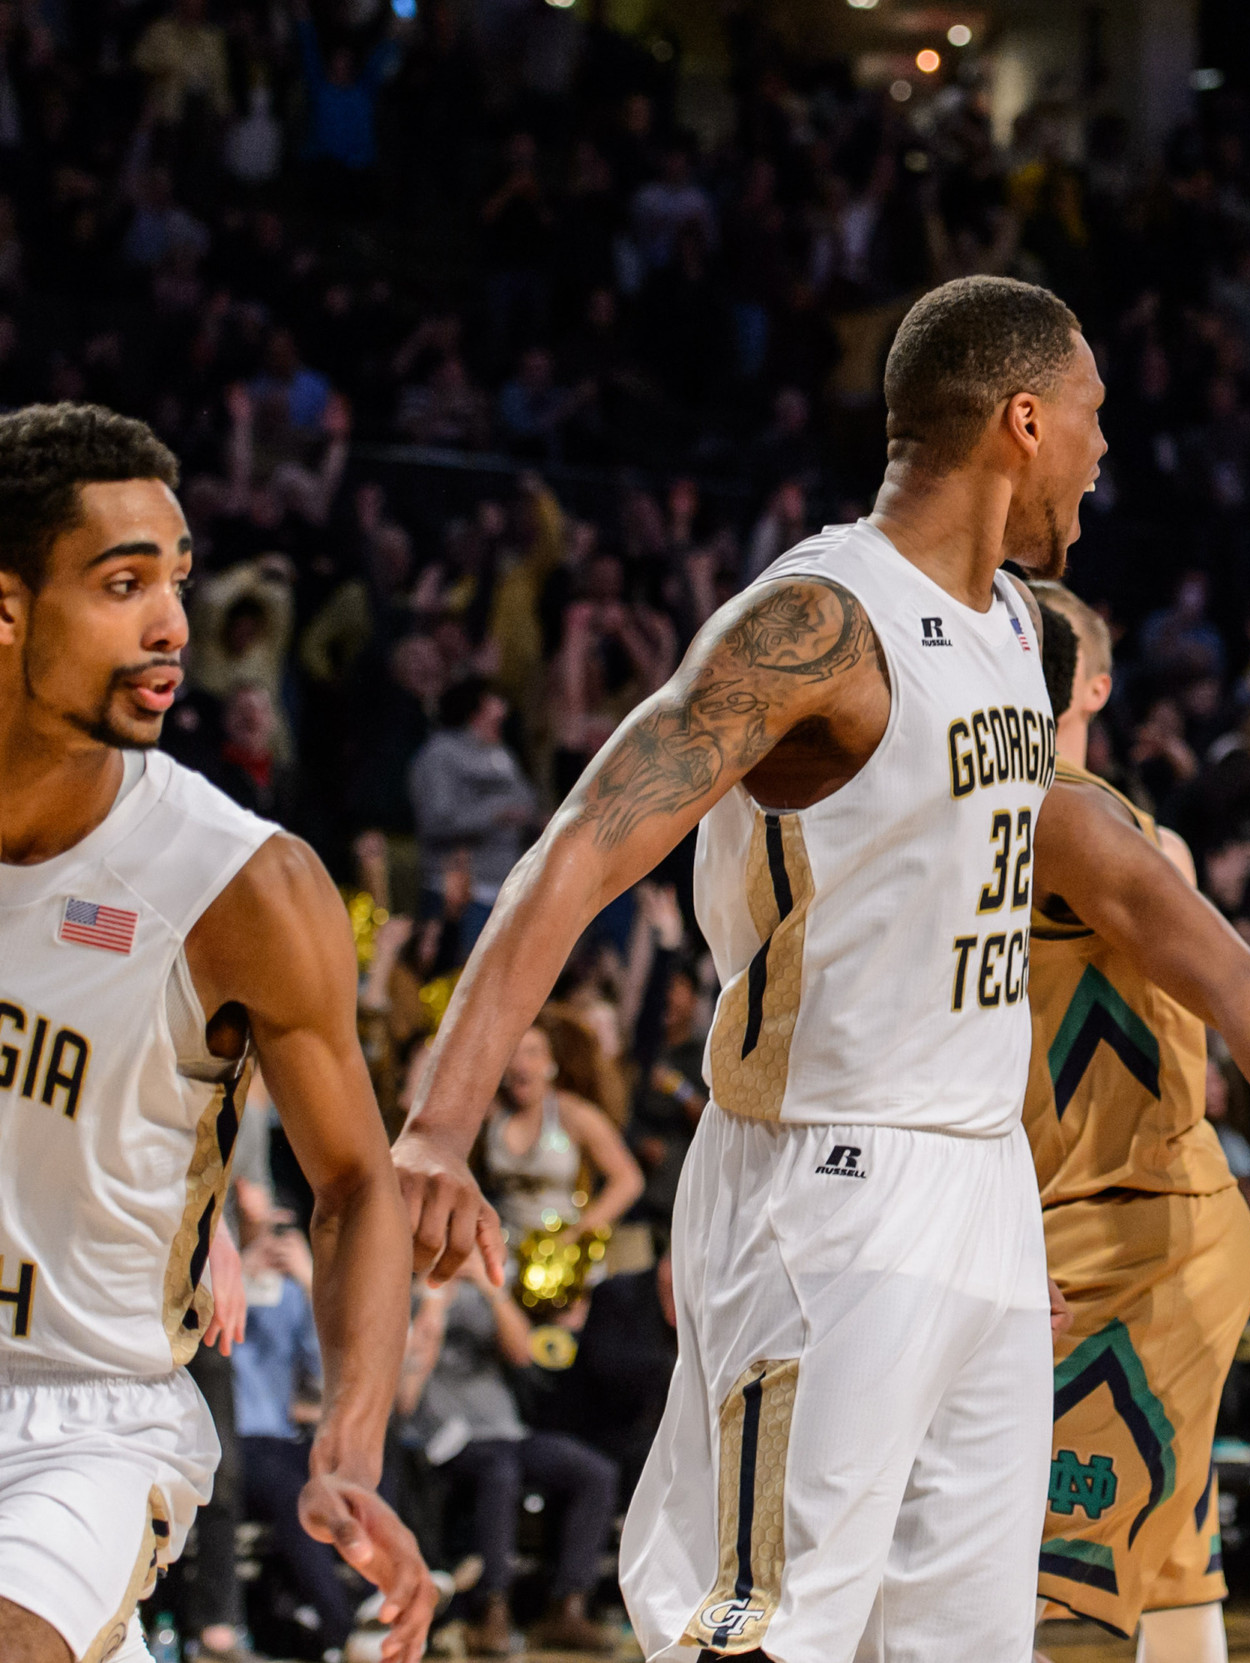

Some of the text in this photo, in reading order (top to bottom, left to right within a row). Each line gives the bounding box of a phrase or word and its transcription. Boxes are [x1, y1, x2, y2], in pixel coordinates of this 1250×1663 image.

[921, 639, 953, 647] RUSSELL
[947, 705, 1056, 800] GEORGIA
[976, 806, 1032, 916] 32
[815, 1166, 867, 1179] RUSSELL
